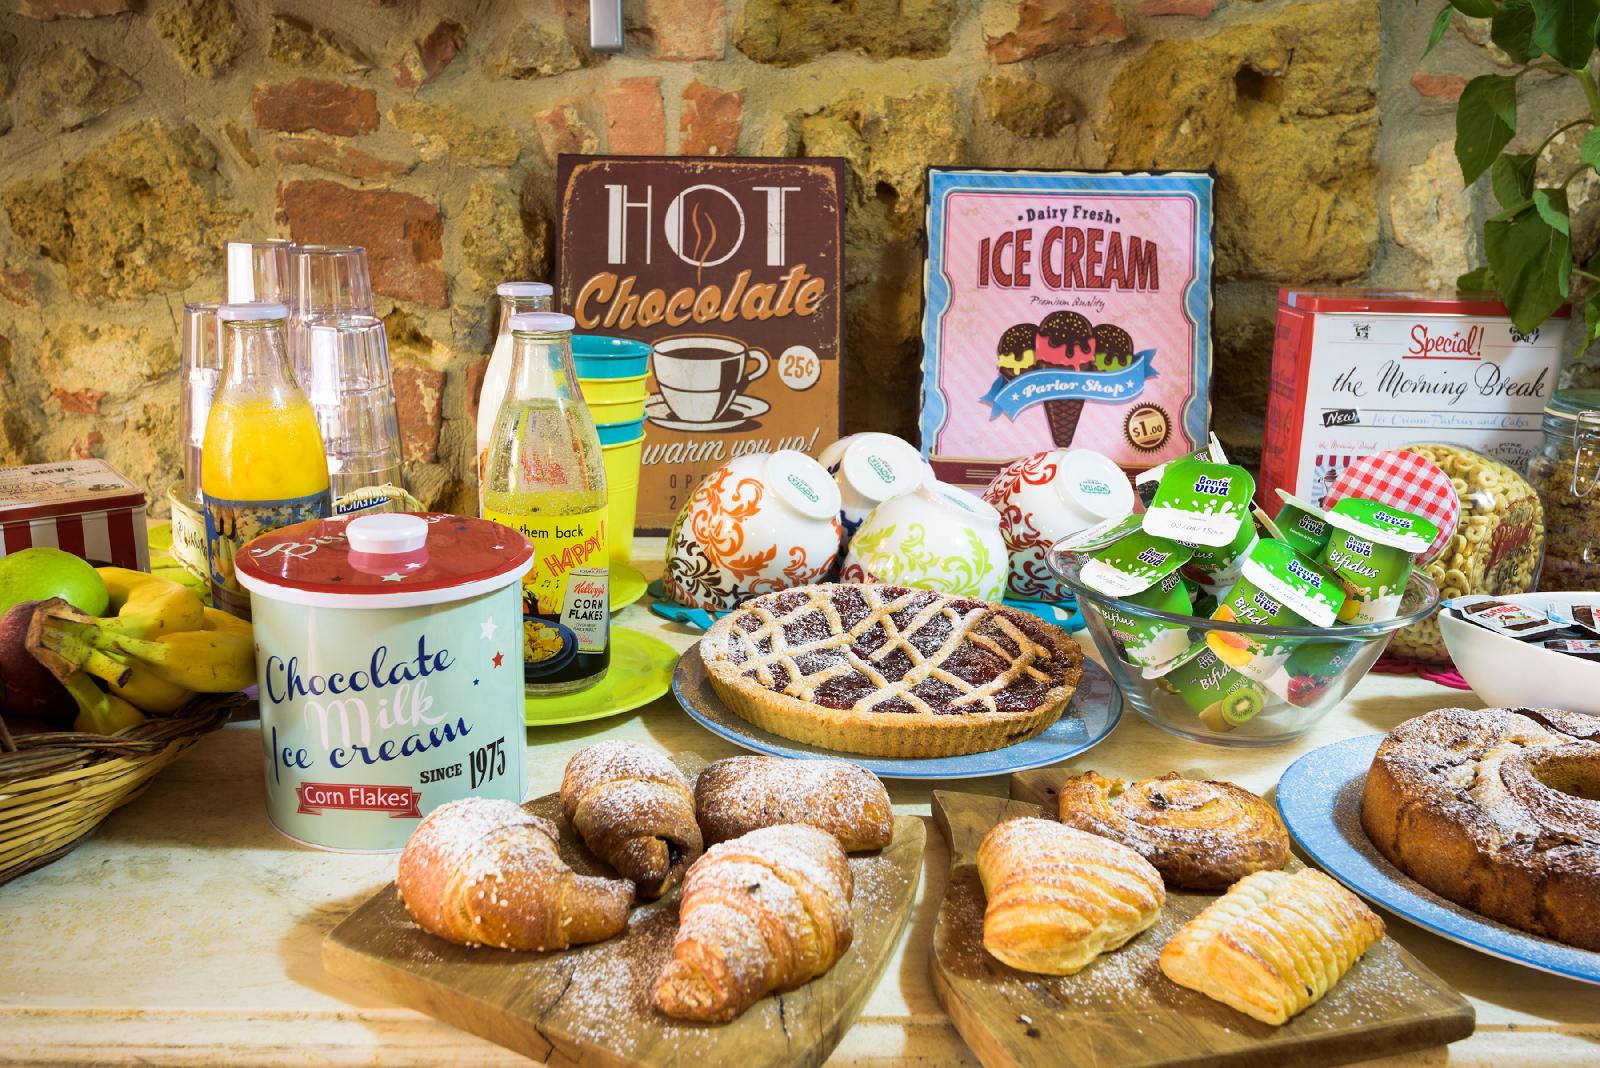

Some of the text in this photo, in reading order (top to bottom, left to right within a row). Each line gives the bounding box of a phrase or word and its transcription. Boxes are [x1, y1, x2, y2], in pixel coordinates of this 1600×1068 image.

[604, 184, 801, 267] HOT
[1026, 205, 1113, 224] Dairy Fresh
[977, 226, 1160, 291] ICE CREAM
[574, 264, 825, 329] Chocolate
[1408, 323, 1486, 357] Special!
[783, 354, 814, 379] 25¢
[1332, 359, 1549, 406] the Morning Break
[1021, 378, 1126, 399] Parlor Shop
[642, 427, 820, 465] warm you up!
[1132, 421, 1164, 437] $1.00
[1194, 483, 1229, 496] viva
[519, 524, 584, 539] them back
[543, 519, 606, 578] HAPPY!
[1329, 548, 1380, 579] Bifidus
[568, 609, 603, 621] FLAKES
[574, 599, 603, 609] CORN
[265, 634, 456, 704] Chocolate
[303, 678, 449, 751] Milk
[271, 717, 474, 786] Ice cream
[420, 736, 507, 790] SINCE 1975
[304, 785, 410, 807] Corn Flakes
